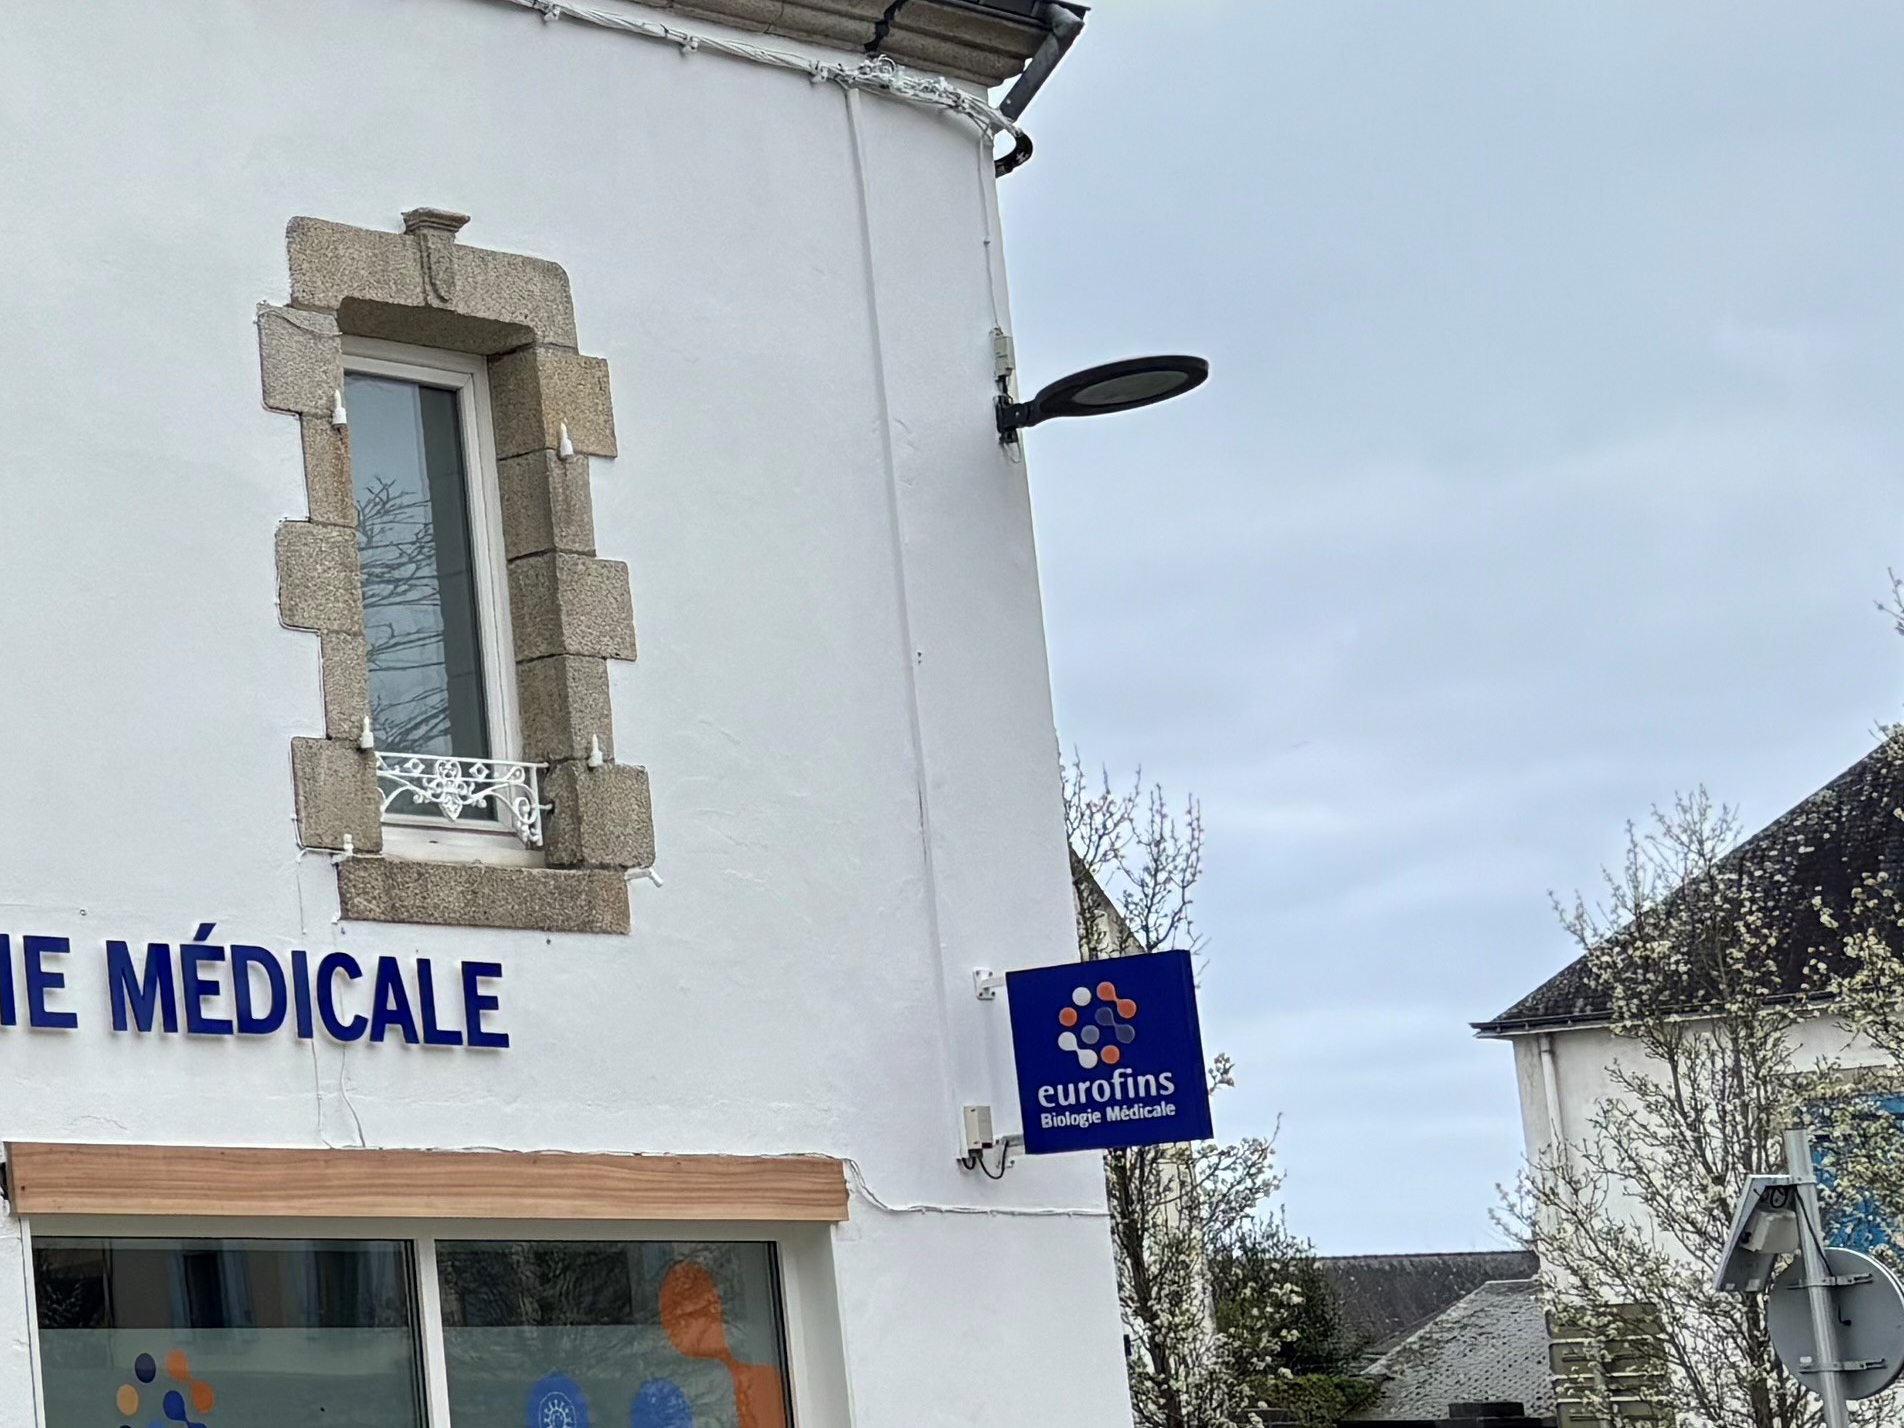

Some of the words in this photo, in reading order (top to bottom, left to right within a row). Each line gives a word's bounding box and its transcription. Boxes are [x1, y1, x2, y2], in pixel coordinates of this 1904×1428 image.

[106, 922, 511, 1050] MÉDICALE
[1038, 1067, 1176, 1108] eurofins
[1041, 1110, 1102, 1129] Biologie
[1106, 1101, 1176, 1122] Médicale
